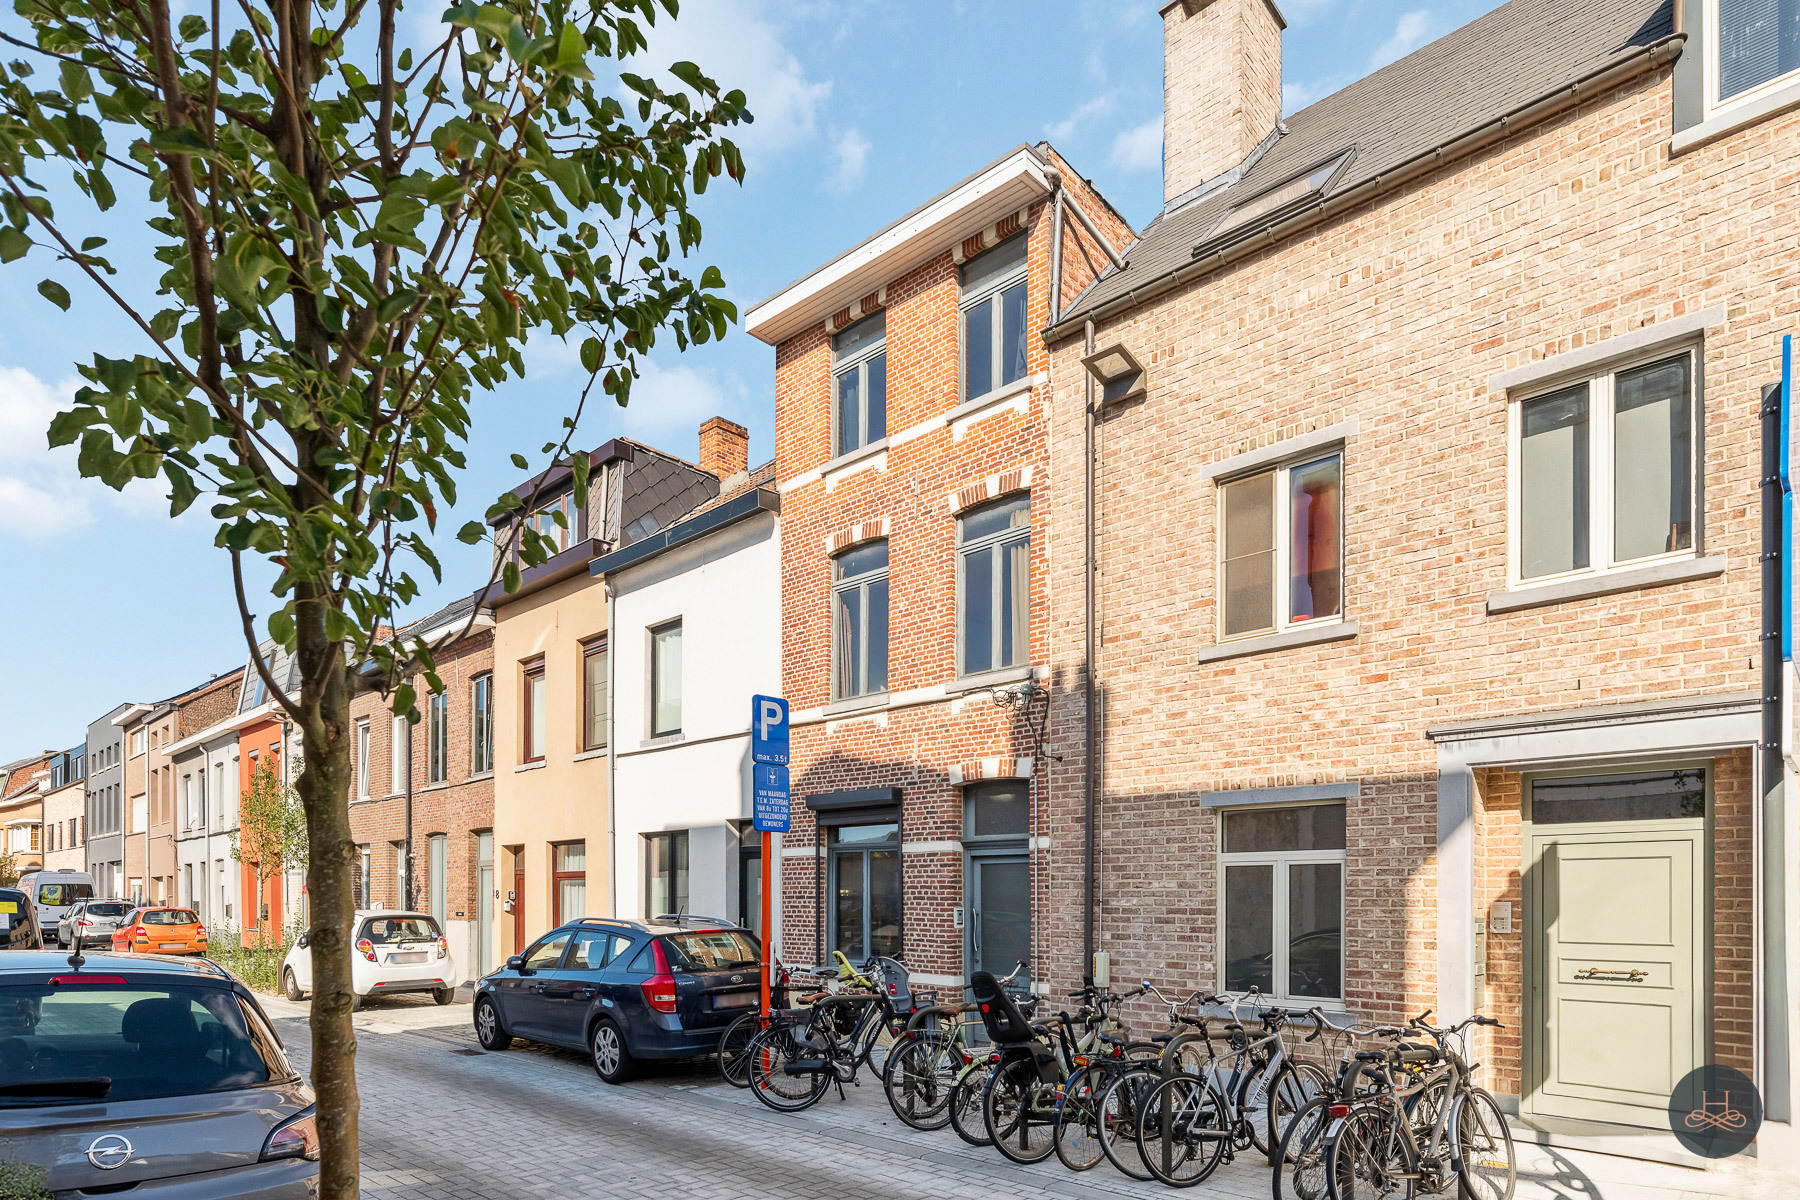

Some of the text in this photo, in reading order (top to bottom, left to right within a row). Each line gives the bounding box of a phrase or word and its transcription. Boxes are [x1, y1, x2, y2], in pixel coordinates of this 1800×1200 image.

[760, 699, 783, 741] P
[768, 790, 786, 798] MAANDAG
[1253, 1076, 1270, 1101] TRIBAN
